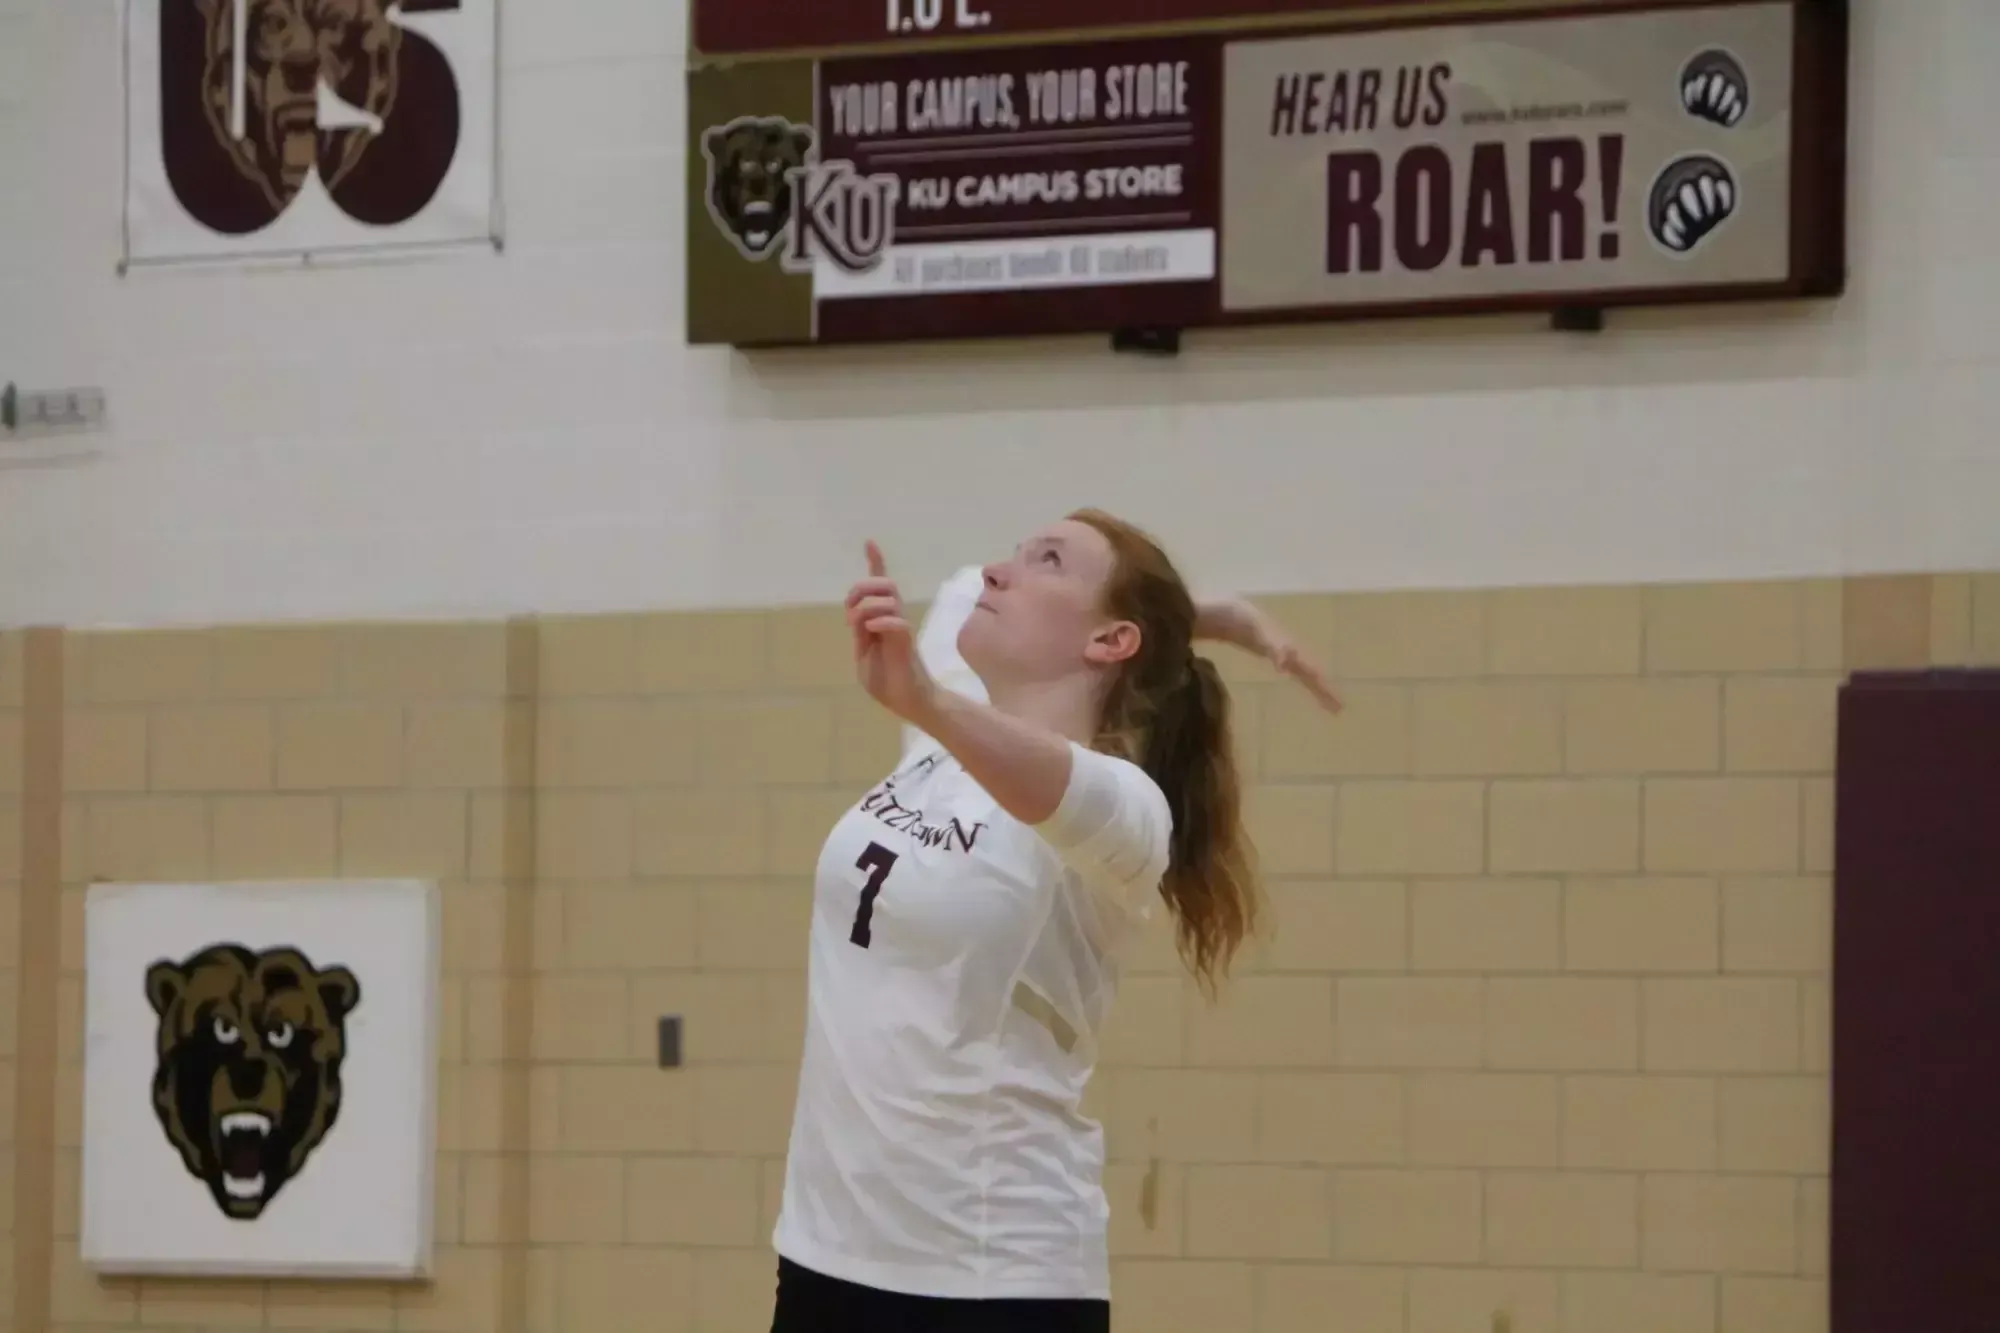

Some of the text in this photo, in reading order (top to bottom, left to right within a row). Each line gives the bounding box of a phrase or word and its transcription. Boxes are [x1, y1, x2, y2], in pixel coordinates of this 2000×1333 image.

[829, 60, 1190, 137] YOUR CAMPUS, YOUR STORE
[1270, 62, 1453, 137] HEAR US
[784, 161, 899, 273] KU
[907, 163, 1184, 211] KU CAMPUS STORE
[1326, 133, 1625, 274] ROAR!
[849, 840, 899, 949] 7
